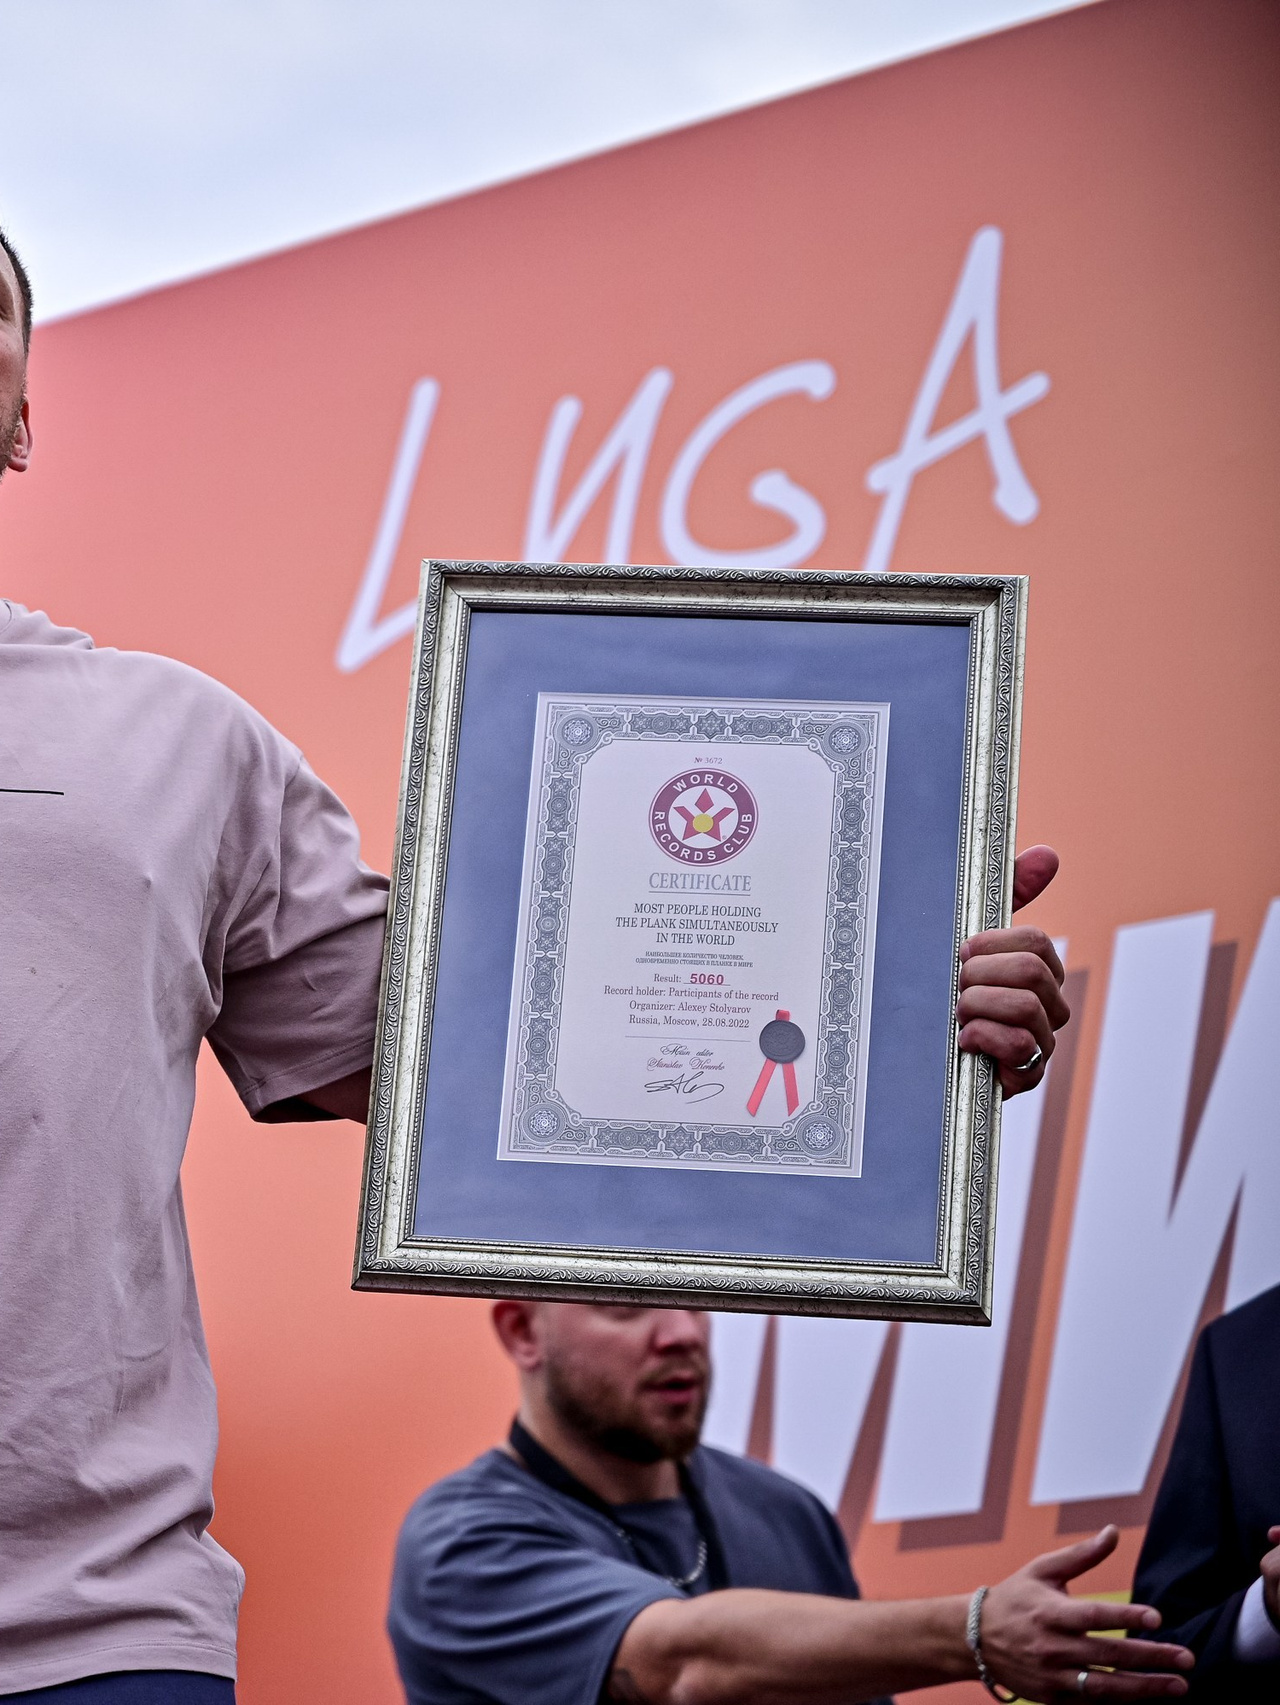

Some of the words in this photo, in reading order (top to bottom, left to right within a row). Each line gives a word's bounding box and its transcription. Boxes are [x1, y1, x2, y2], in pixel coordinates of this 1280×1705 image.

[704, 757, 723, 765] 3672
[672, 774, 739, 793] WORLD
[654, 811, 716, 861] RECORDS
[723, 813, 752, 853] CLUB
[648, 872, 752, 892] CERTIFICATE
[634, 903, 664, 914] MOST
[666, 904, 708, 916] PEOPLE
[711, 905, 761, 918] HOLDING
[615, 917, 637, 928] THE
[640, 918, 676, 929] PLANK
[678, 919, 779, 933] SIMULTANEOUSLY
[656, 932, 669, 943] IN
[671, 933, 693, 944] THE
[696, 934, 735, 946] WORLD
[653, 973, 682, 983] Result:
[689, 973, 725, 985] 5060
[603, 985, 633, 996] Record
[636, 986, 666, 997] holder:
[668, 987, 722, 1000] Participants
[724, 988, 733, 999] of
[734, 990, 749, 1000] the
[751, 992, 779, 1001] record
[629, 1000, 676, 1012] Organizer:
[677, 1001, 708, 1013] Alexey
[709, 1003, 752, 1015] Stolyarov
[628, 1014, 661, 1026] Russia,
[663, 1015, 700, 1027] Moscow,
[702, 1018, 750, 1029] 28.08.2022
[660, 1043, 691, 1057] Main
[695, 1048, 714, 1057] editor
